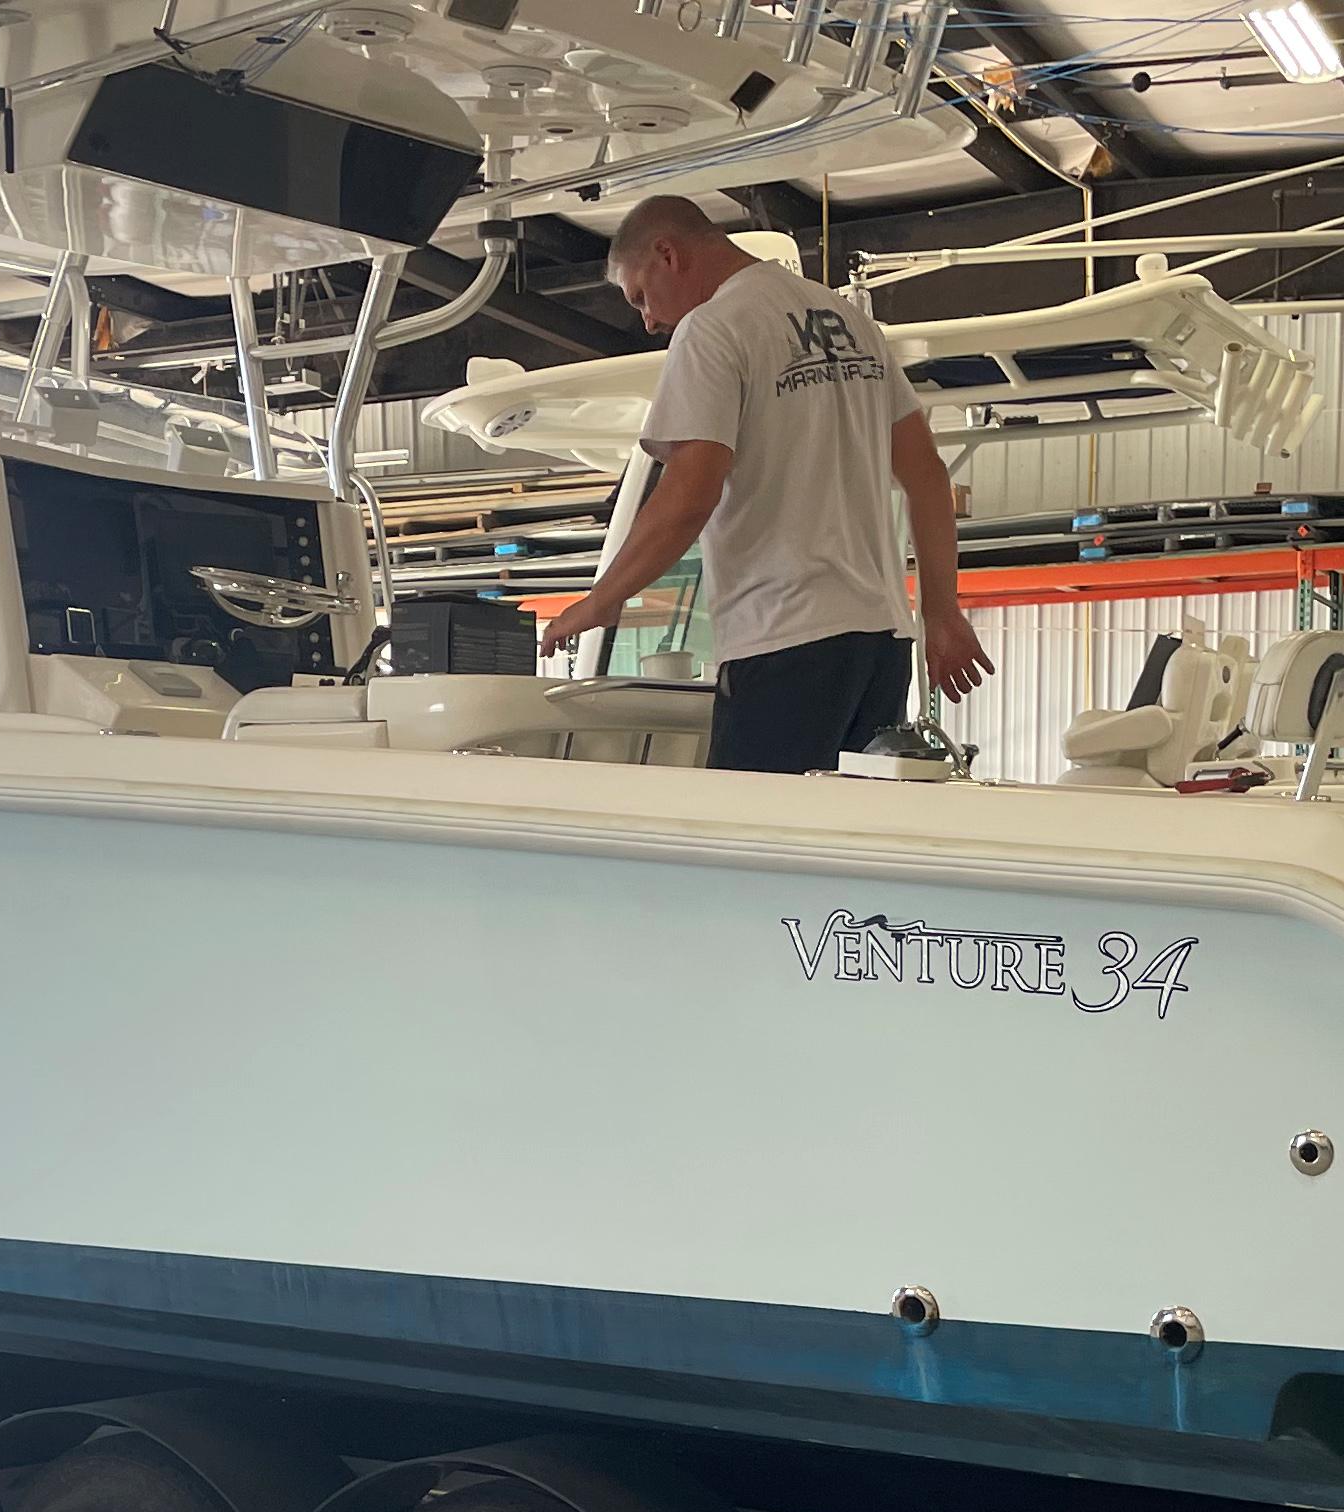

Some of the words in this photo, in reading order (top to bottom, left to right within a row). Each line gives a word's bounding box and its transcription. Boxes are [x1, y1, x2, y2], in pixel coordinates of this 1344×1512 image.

[776, 365, 835, 398] MARIN
[781, 909, 1066, 995] VENTURE
[1070, 931, 1199, 1019] 34
